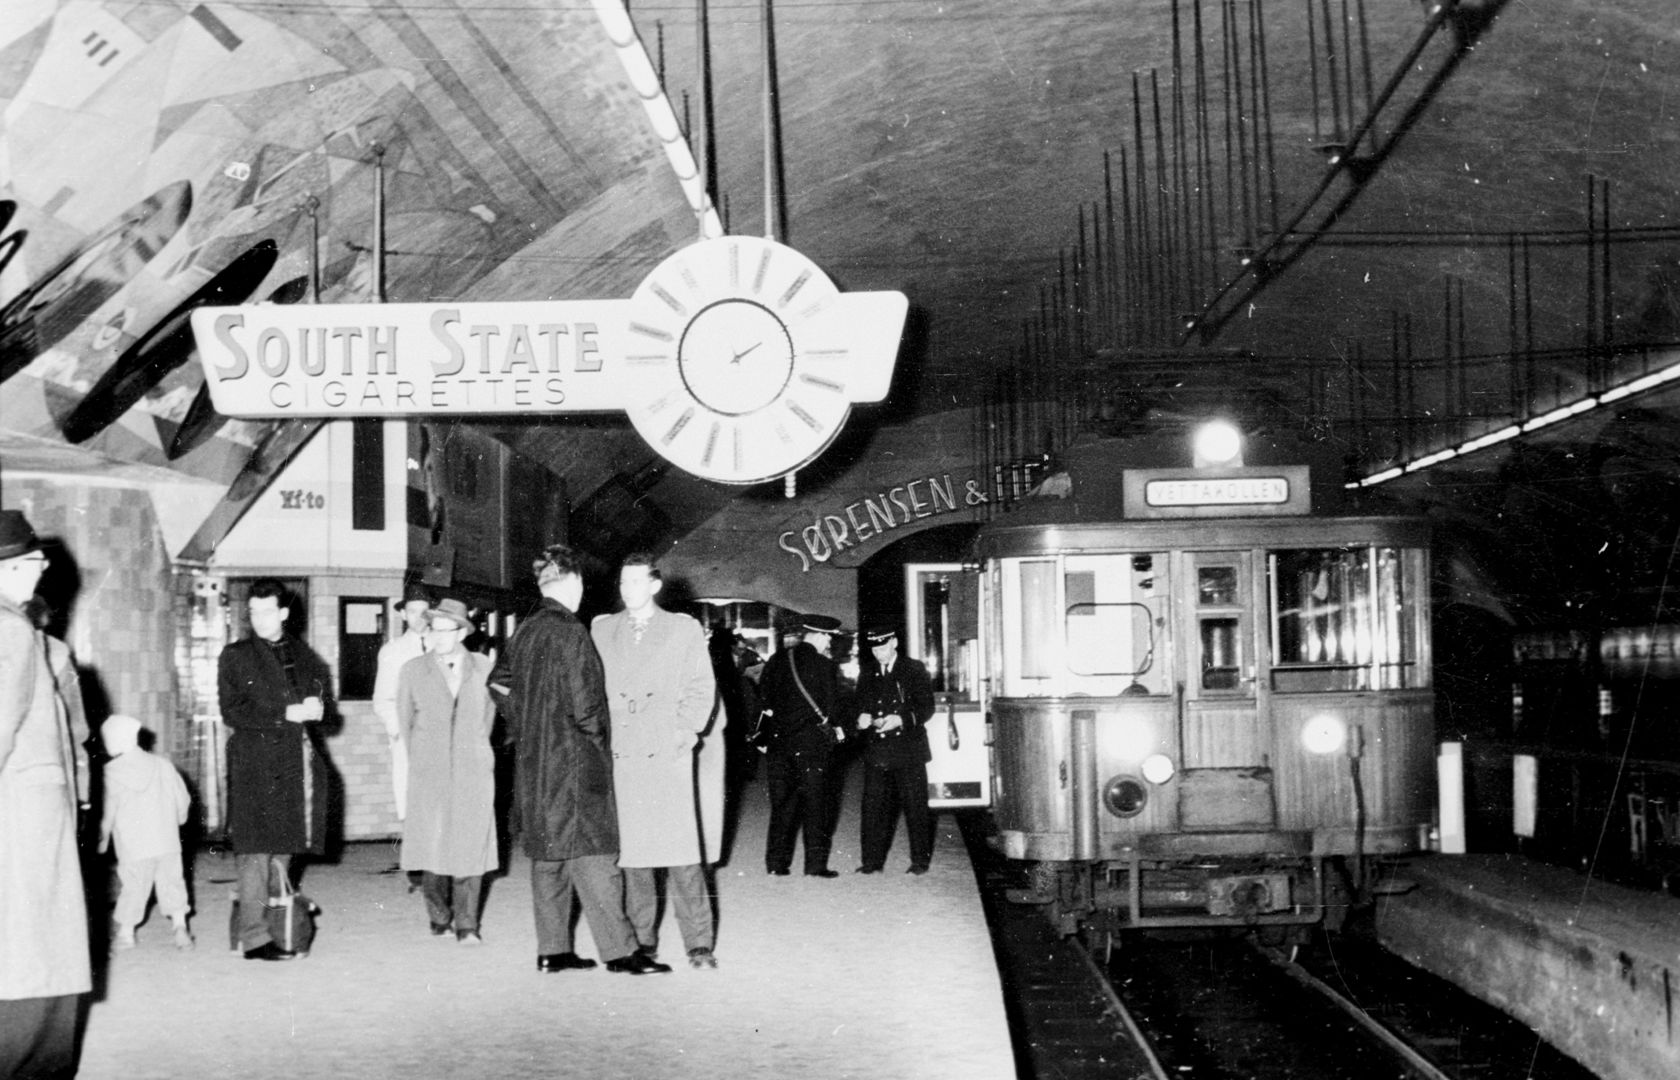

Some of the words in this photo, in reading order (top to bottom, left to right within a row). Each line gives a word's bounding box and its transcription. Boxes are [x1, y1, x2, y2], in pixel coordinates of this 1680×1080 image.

[213, 313, 399, 383] SOUTH
[429, 308, 604, 379] STATE
[268, 378, 567, 409] CIGARETTES
[778, 473, 957, 573] SØRENSEN
[964, 479, 989, 506] &
